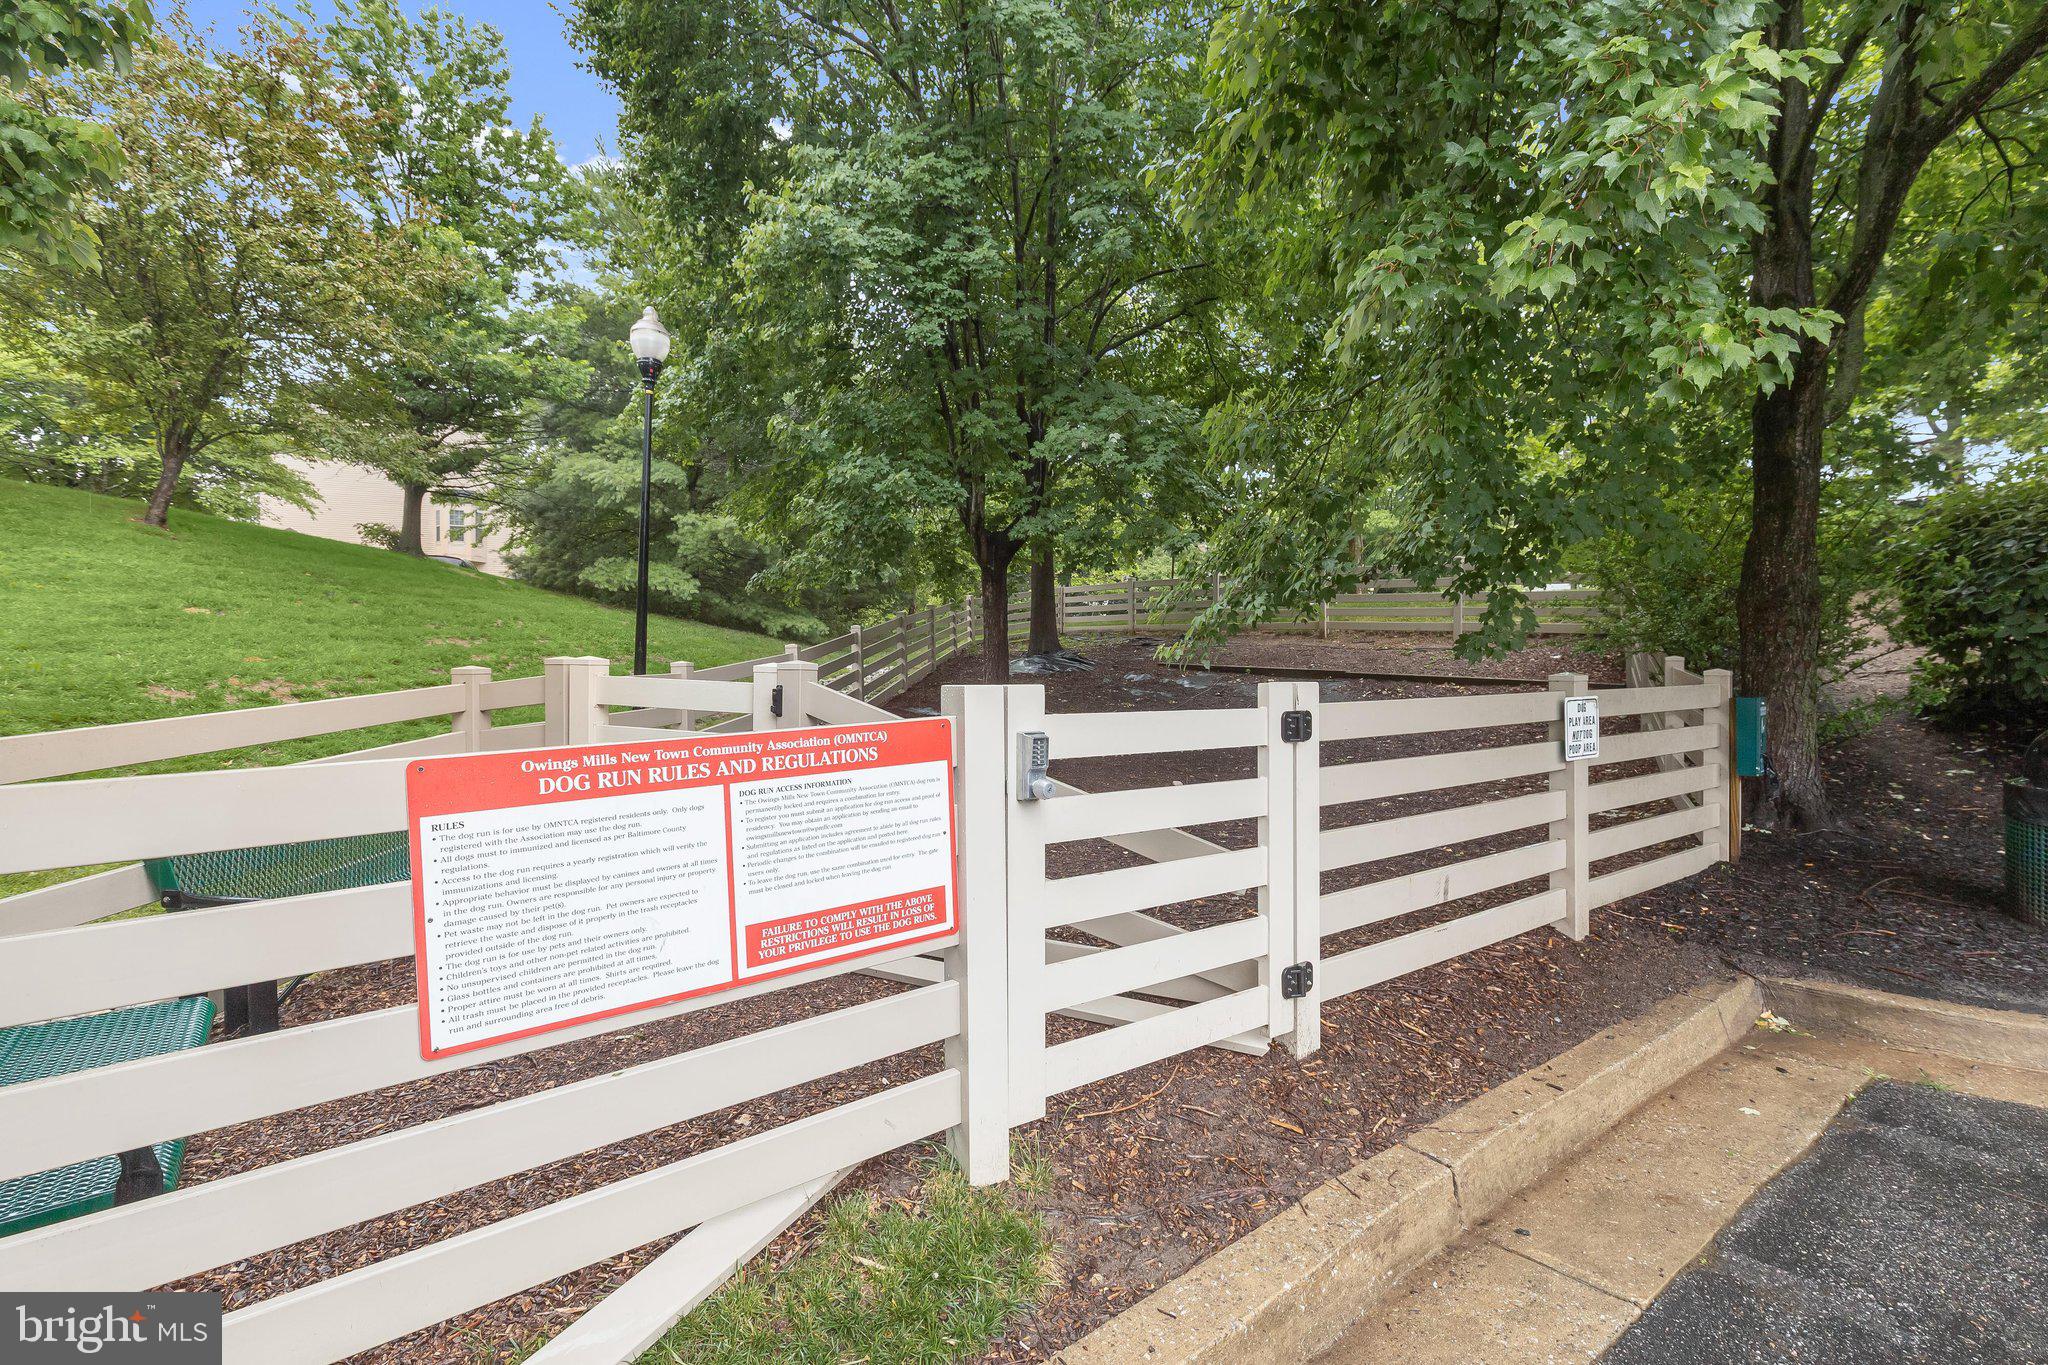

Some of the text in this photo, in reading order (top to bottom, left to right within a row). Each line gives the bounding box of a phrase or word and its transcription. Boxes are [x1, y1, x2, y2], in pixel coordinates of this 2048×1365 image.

[1569, 715, 1595, 727] PLAY AREA
[1577, 702, 1586, 712] DOG
[1569, 742, 1595, 754] POOP AREA
[1572, 729, 1592, 741] NOT DOG
[520, 732, 887, 773] Owings Mills New Town Community Association (OMNTCA)
[538, 747, 878, 794] DOG RUN RULES AND REGULATIONS
[738, 778, 852, 797] DOG RUN ACCESS INFORMATION
[430, 821, 465, 832] RULES
[438, 833, 456, 842] The
[457, 832, 474, 840] dog
[531, 823, 541, 832] by
[543, 818, 579, 829] OMNTCA
[580, 814, 617, 825] registered
[618, 811, 651, 820] residents
[688, 804, 704, 812] dogs
[440, 840, 482, 853] registered
[484, 838, 502, 847] with
[504, 836, 518, 844] the
[519, 832, 565, 842] Association
[612, 823, 626, 831] dog
[439, 855, 452, 863] All
[454, 854, 474, 862] dogs
[476, 850, 497, 858] must
[509, 842, 553, 854] immunized
[554, 839, 569, 848] and
[571, 835, 601, 846] licensed
[613, 834, 625, 842] per
[627, 829, 661, 838] Baltimore
[662, 825, 686, 833] County
[441, 875, 470, 885] Access
[483, 870, 497, 878] the
[532, 862, 564, 872] requires
[572, 856, 596, 867] yearly
[597, 851, 638, 862] registration
[639, 846, 661, 855] which
[662, 844, 674, 852] will
[676, 842, 695, 850] verify
[442, 881, 503, 895] immunizations
[504, 877, 520, 886] and
[443, 917, 476, 927] damage
[478, 910, 507, 921] caused
[509, 908, 520, 917] by
[521, 905, 540, 914] their
[760, 903, 934, 949] RESTRICTIONS WILL RESULT IN LOSS OF
[762, 894, 932, 938] FAILURE TO COMPLY WITH THE ABOVE
[445, 946, 483, 962] provided
[484, 941, 515, 952] outside
[516, 938, 525, 946] of
[527, 936, 540, 944] the
[541, 934, 556, 942] dog
[445, 961, 462, 970] The
[464, 959, 480, 967] dog
[482, 955, 496, 963] run
[537, 945, 547, 953] by
[548, 942, 566, 952] pets
[567, 937, 582, 946] and
[583, 935, 601, 943] their
[602, 930, 629, 940] owners
[758, 912, 936, 960] YOUR PRIVILEGE TO USE THE DOG RUNS.
[448, 1026, 464, 1034] run
[466, 1020, 482, 1030] and
[484, 1010, 533, 1026] surrounding
[535, 1005, 553, 1014] area
[554, 1002, 570, 1010] free
[570, 998, 579, 1006] of
